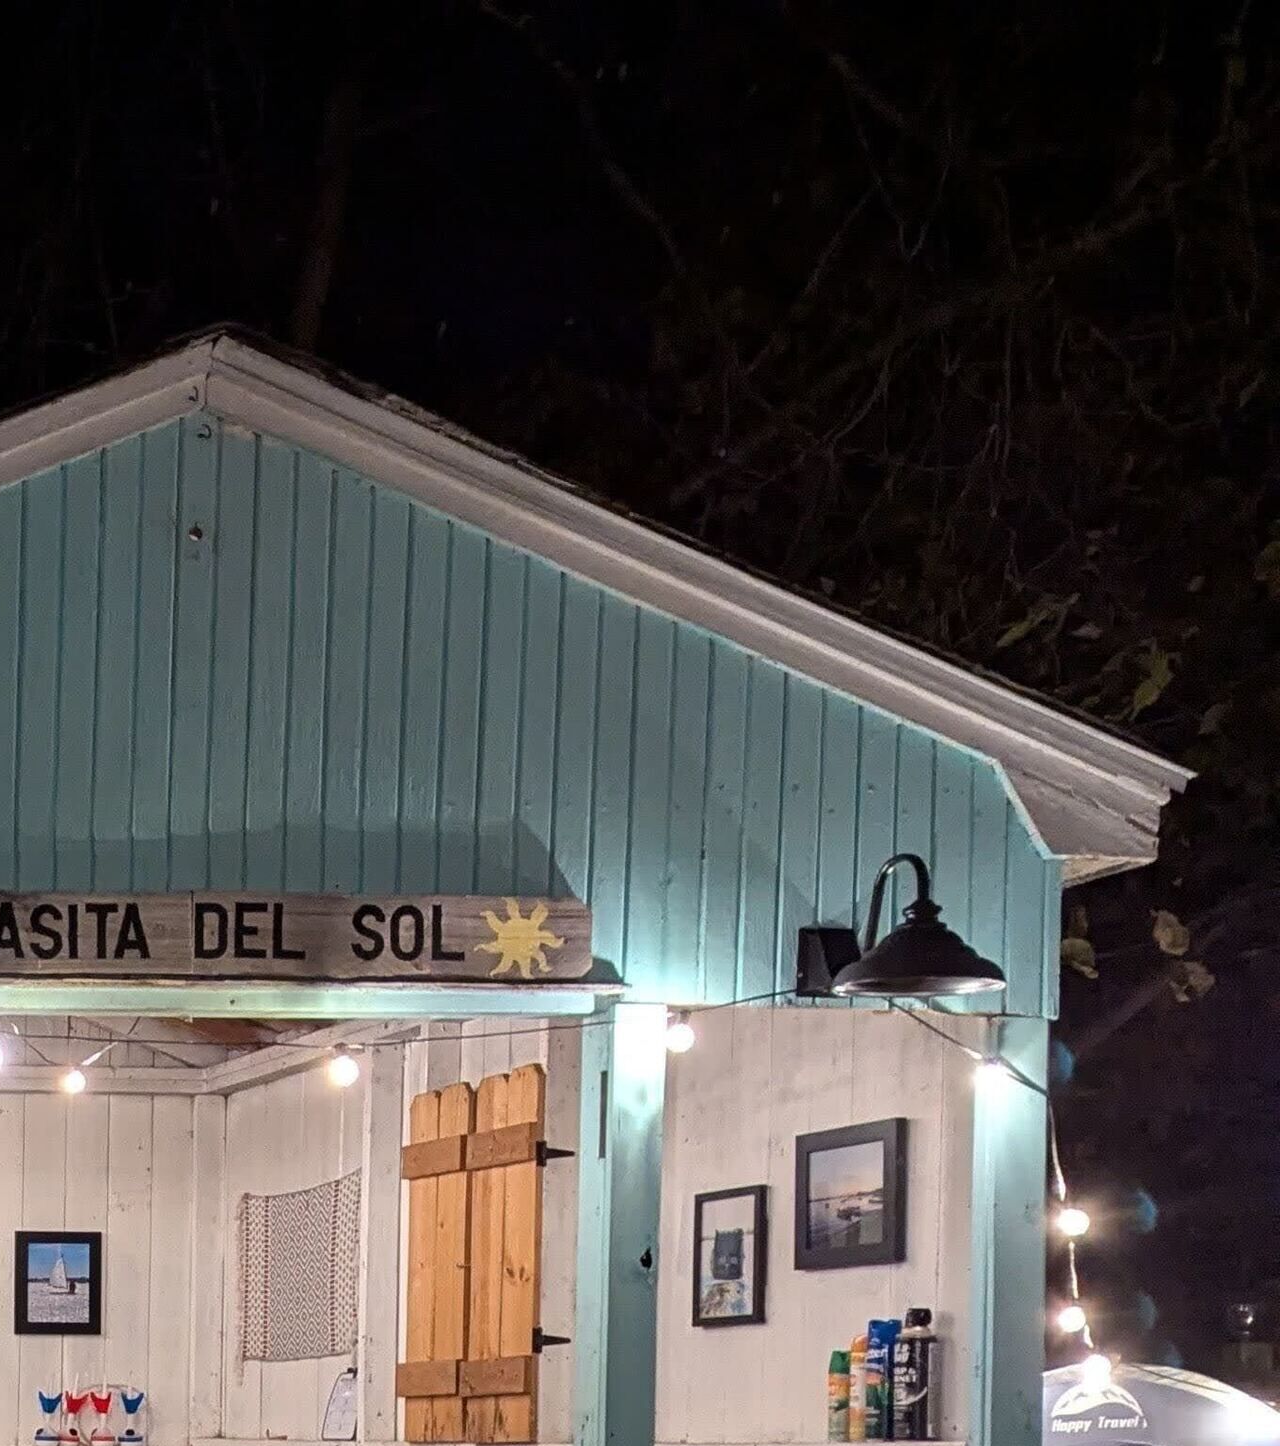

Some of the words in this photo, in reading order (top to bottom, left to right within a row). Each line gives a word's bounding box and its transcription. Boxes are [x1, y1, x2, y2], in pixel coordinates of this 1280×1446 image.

[193, 901, 307, 960] DEL
[350, 903, 466, 962] SOL
[1051, 1419, 1093, 1433] Happy
